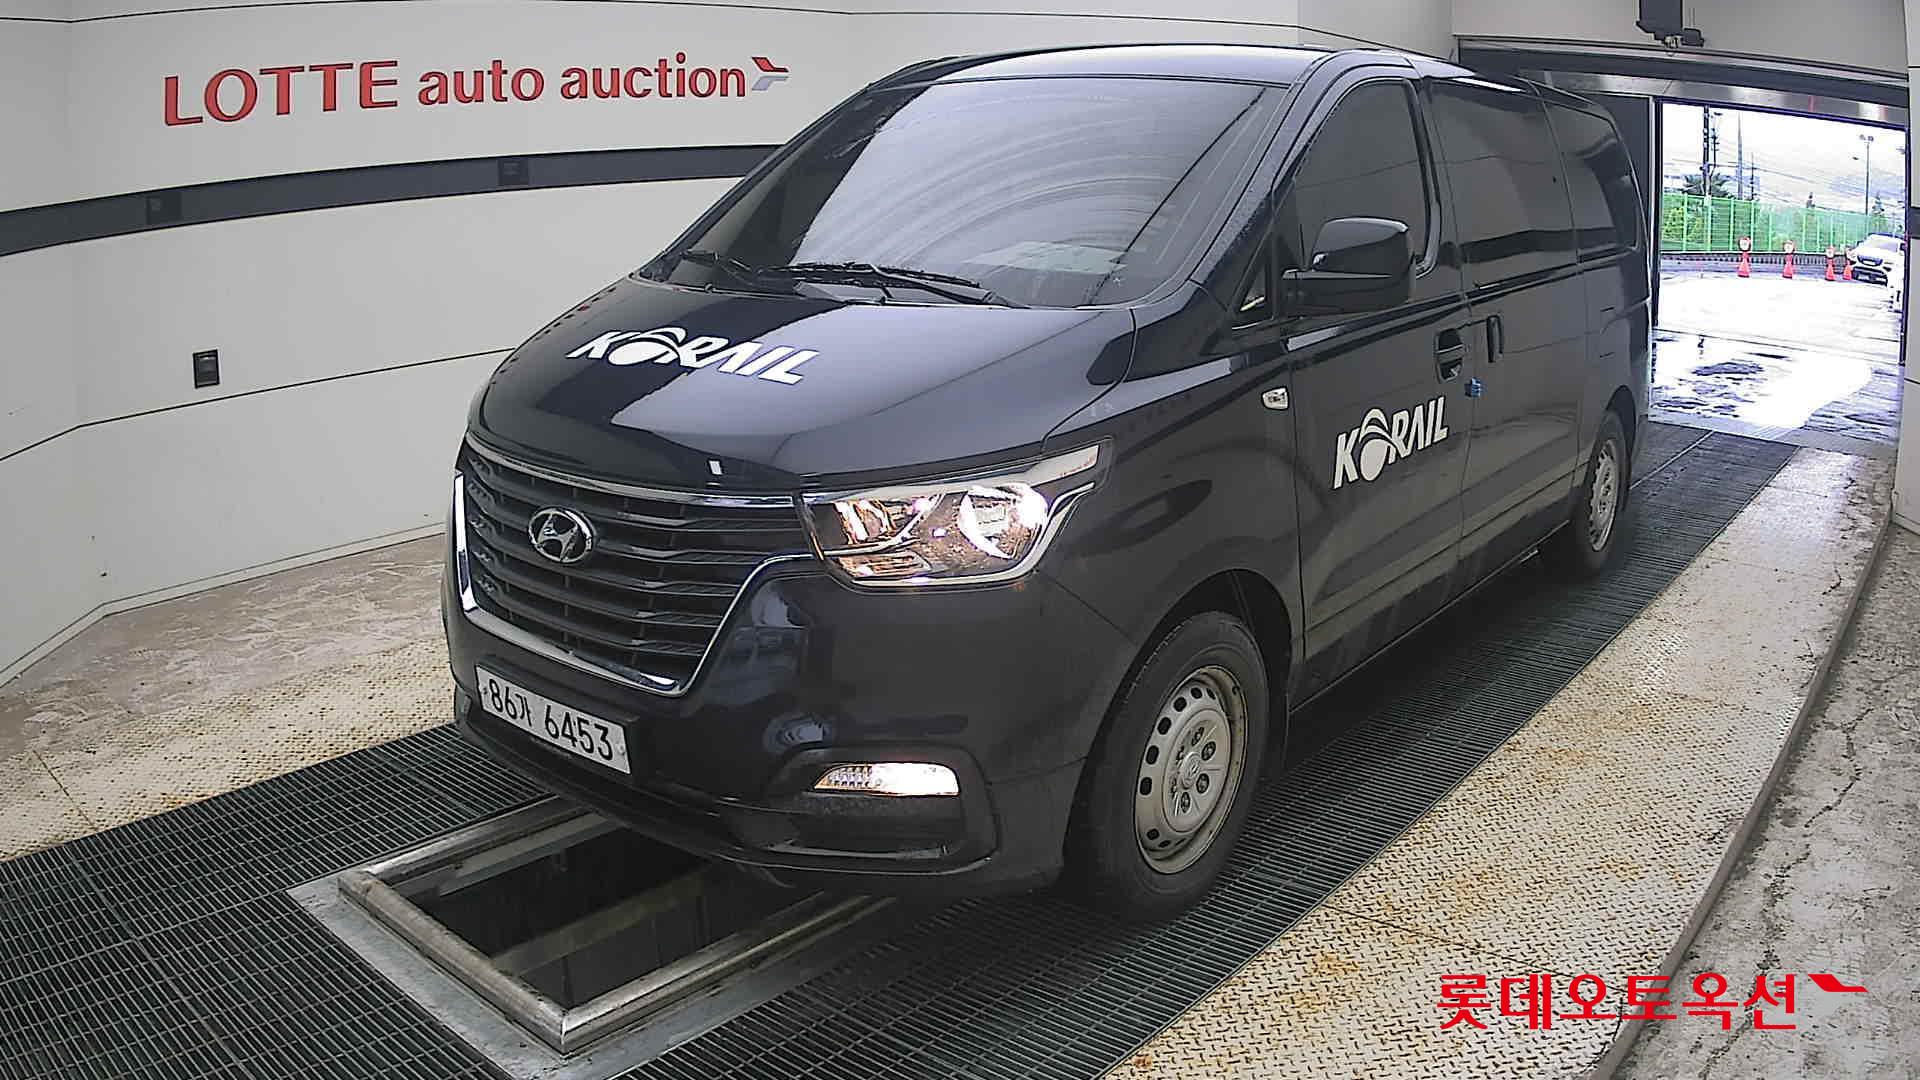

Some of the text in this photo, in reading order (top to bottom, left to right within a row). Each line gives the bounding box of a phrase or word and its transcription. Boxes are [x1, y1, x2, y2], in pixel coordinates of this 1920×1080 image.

[164, 51, 746, 126] LOTTE auto auction
[565, 327, 820, 385] KORAIL
[1333, 396, 1449, 489] KORAIL
[489, 679, 613, 761] 86가 6453
